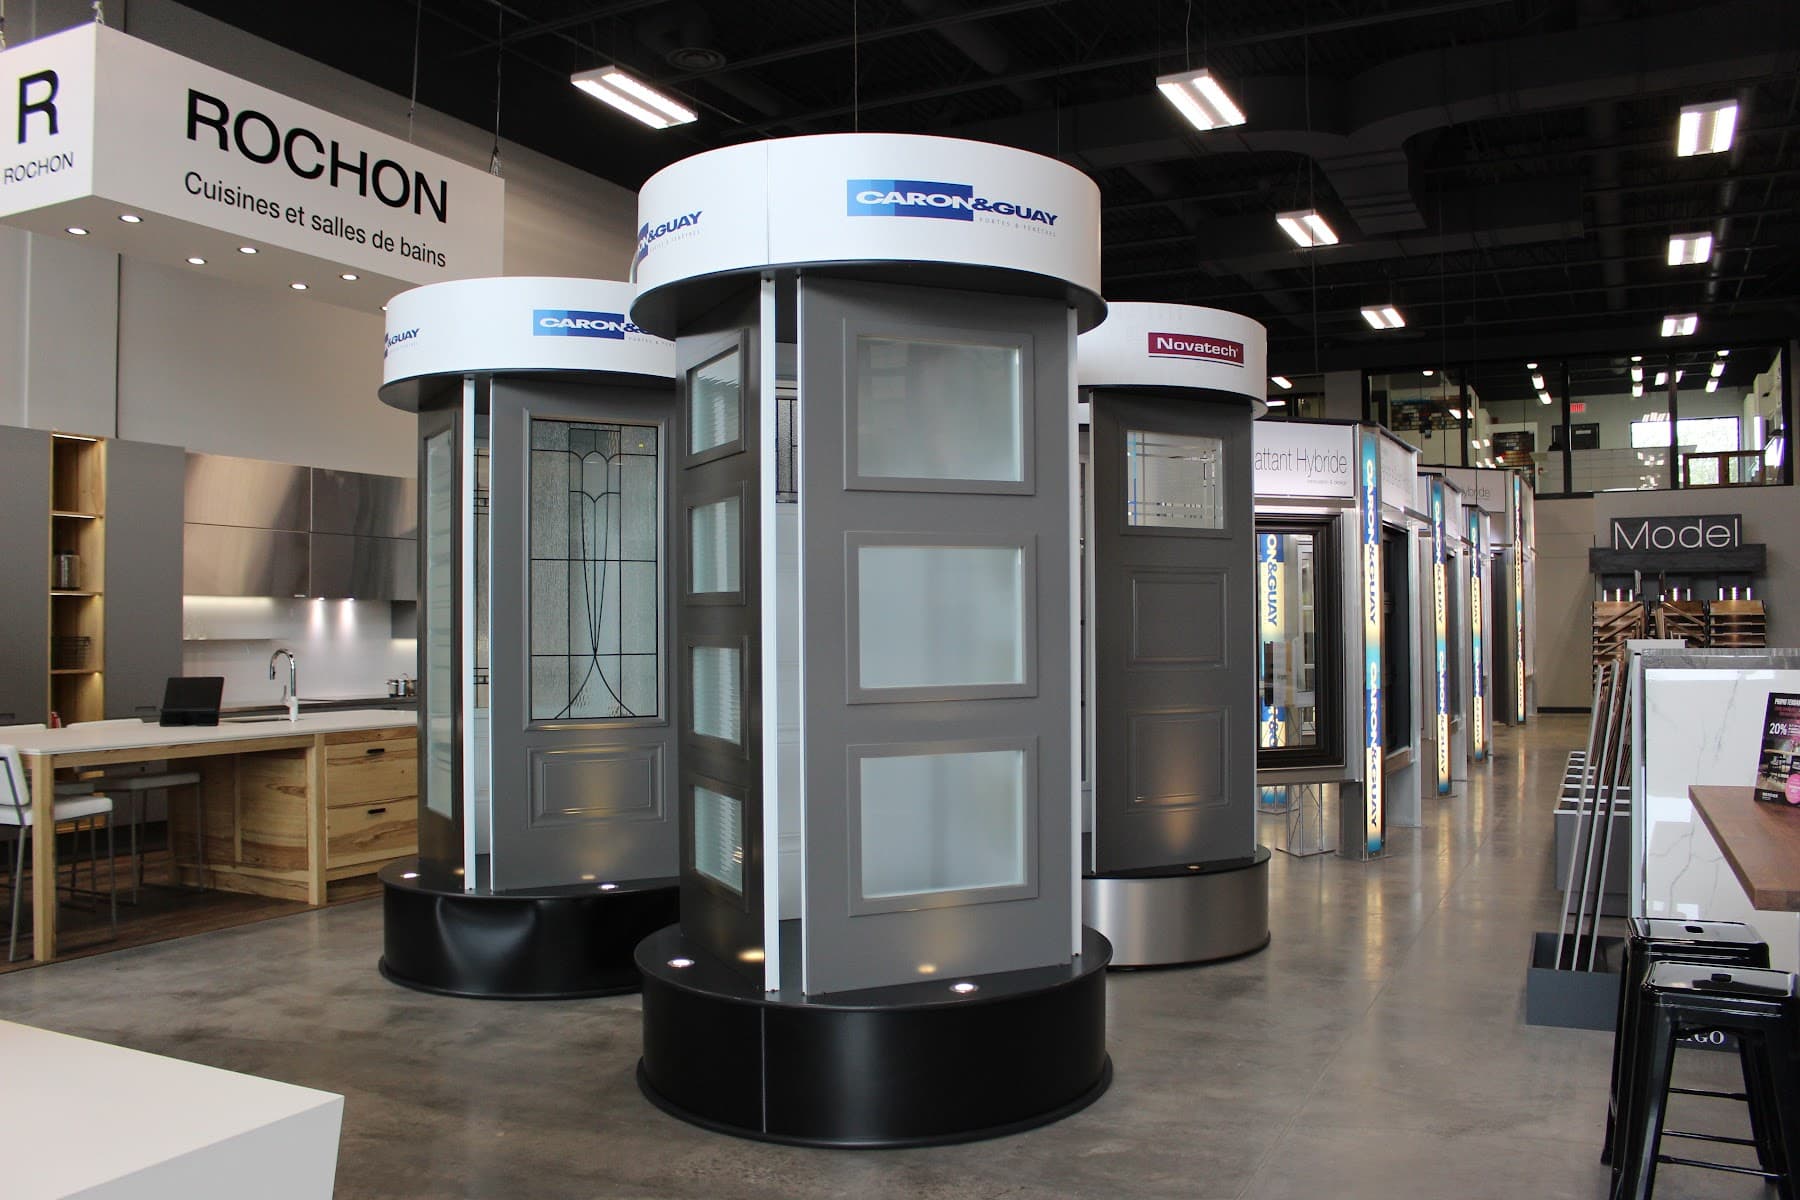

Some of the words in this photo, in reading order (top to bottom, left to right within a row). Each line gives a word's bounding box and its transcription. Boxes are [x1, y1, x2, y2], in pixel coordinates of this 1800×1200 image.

[18, 69, 59, 144] R
[4, 151, 74, 184] ROCHON
[187, 88, 448, 224] ROCHON
[185, 171, 280, 219] Cuisines
[285, 206, 305, 226] et
[311, 214, 366, 244] salles
[372, 230, 395, 252] de
[401, 236, 446, 267] bains
[855, 190, 1058, 226] CARON&GUAY
[539, 317, 648, 335] CARON&
[1297, 448, 1347, 477] Hybride
[1614, 518, 1738, 550] Model
[1769, 722, 1787, 735] 20%
